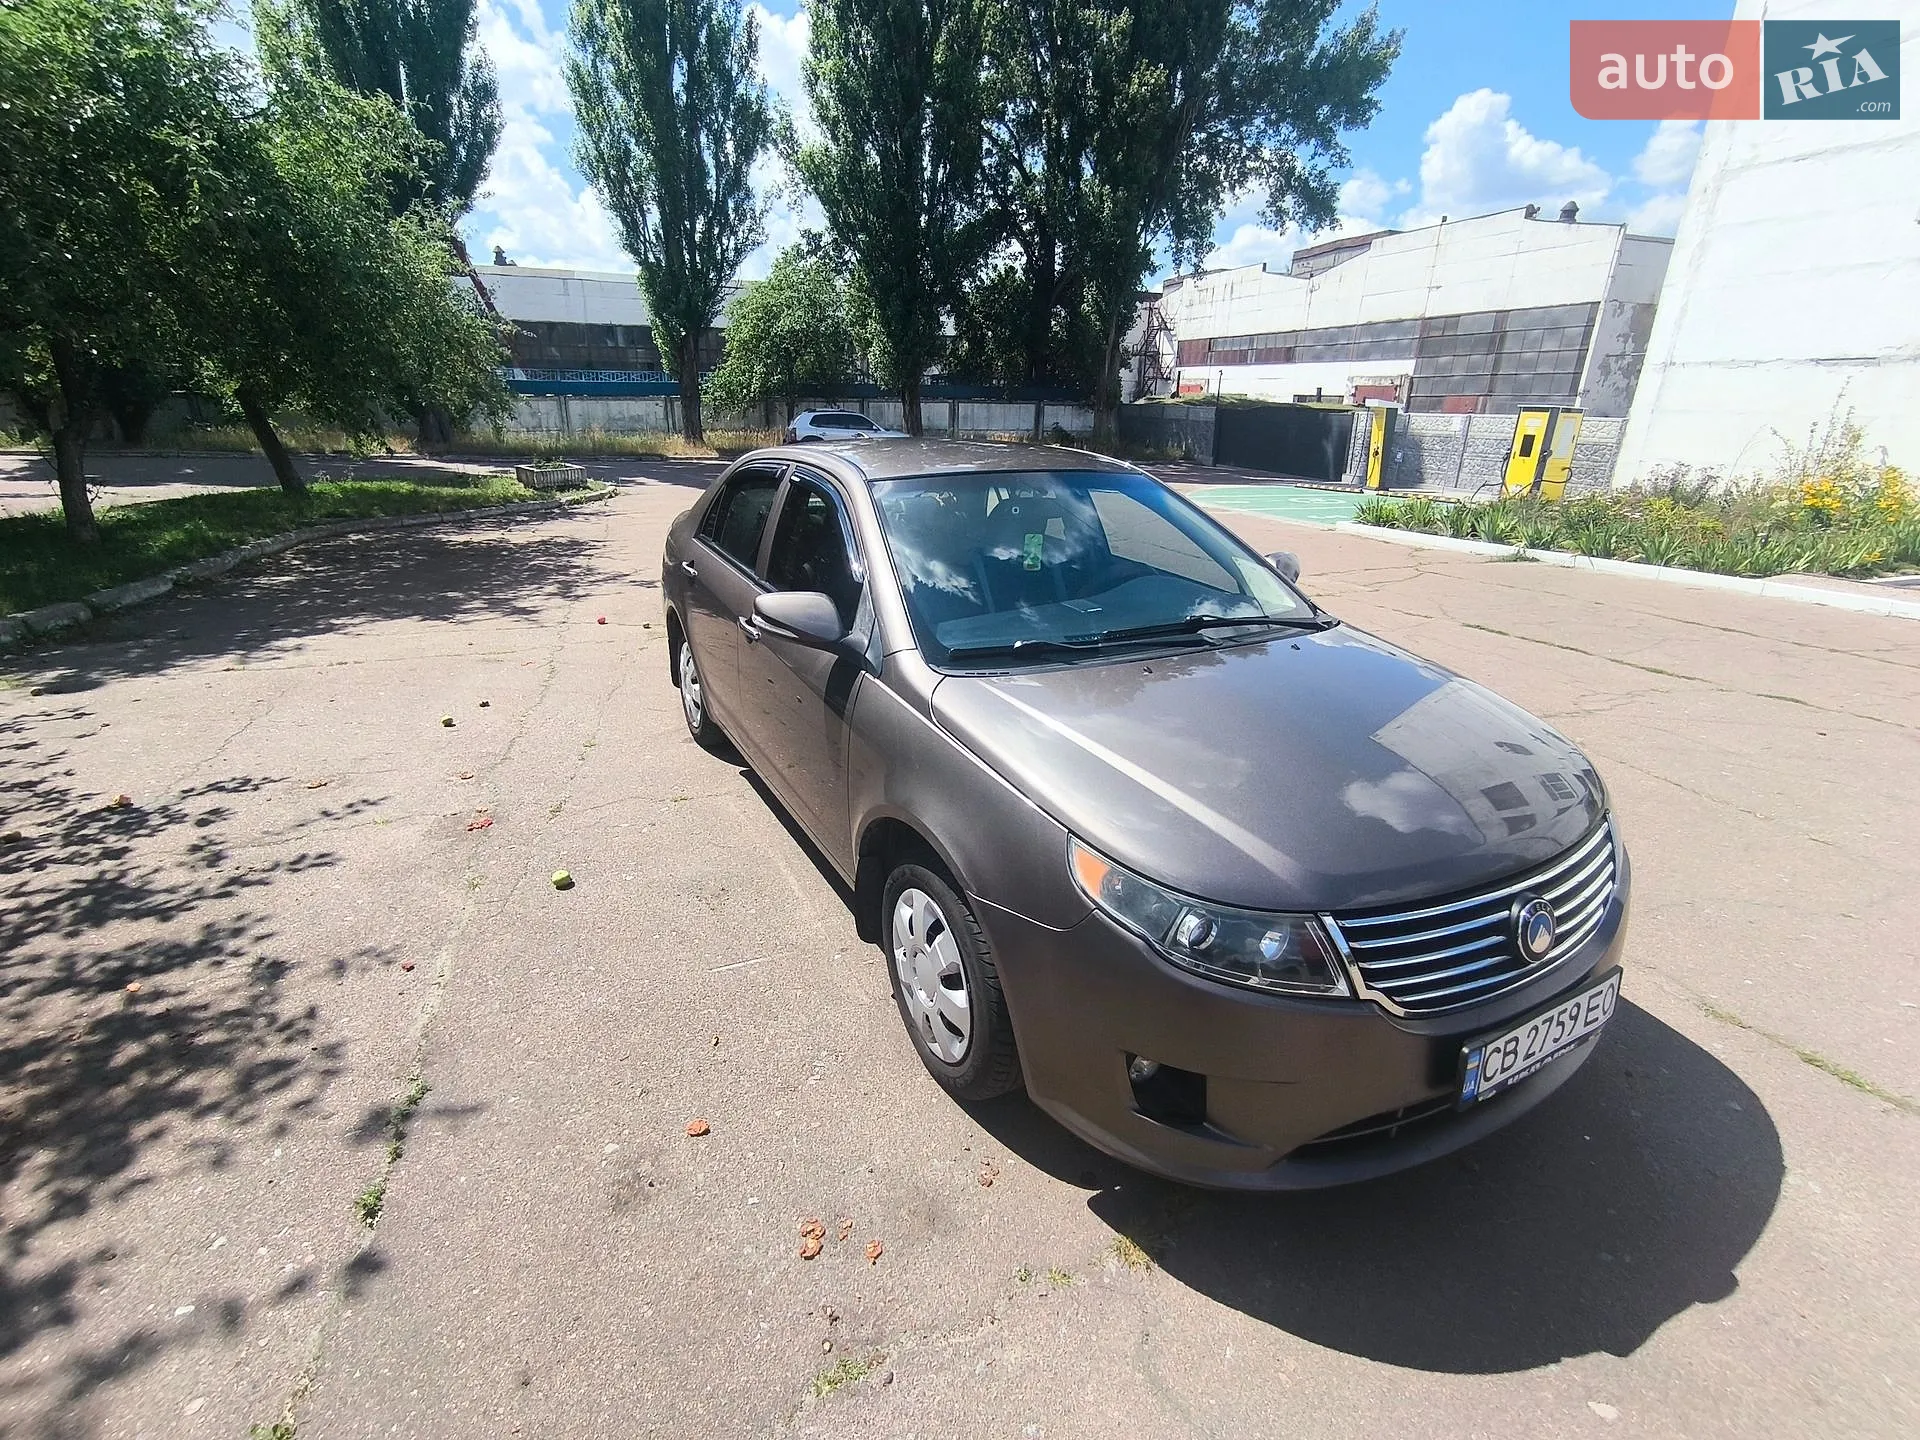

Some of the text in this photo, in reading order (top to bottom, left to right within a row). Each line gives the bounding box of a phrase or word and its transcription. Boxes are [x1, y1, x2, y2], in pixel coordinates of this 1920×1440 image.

[1482, 1036, 1520, 1082] CB
[1522, 1001, 1582, 1062] 2759
[1583, 982, 1616, 1028] EO
